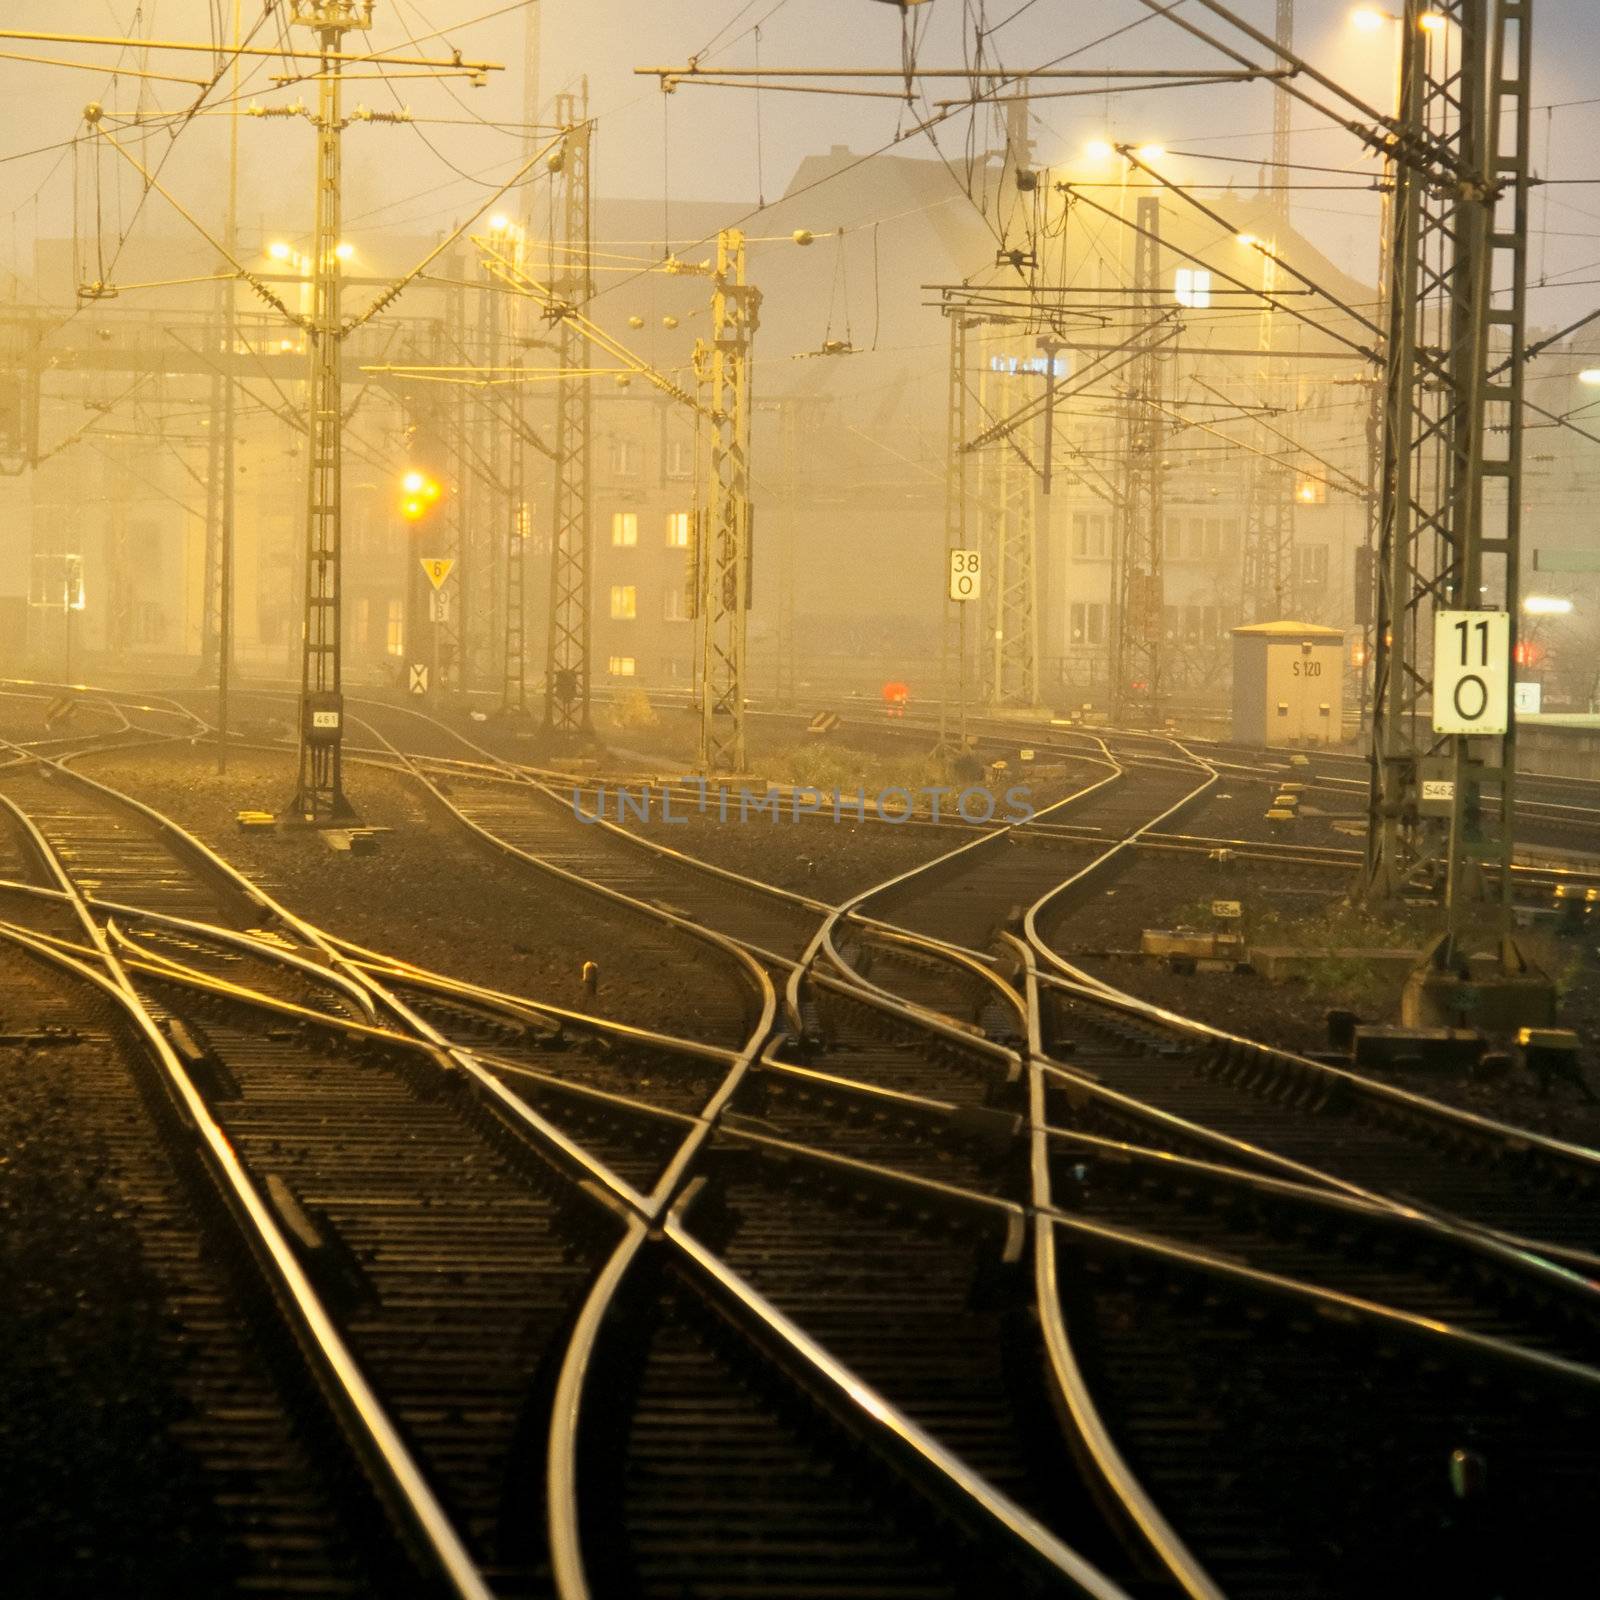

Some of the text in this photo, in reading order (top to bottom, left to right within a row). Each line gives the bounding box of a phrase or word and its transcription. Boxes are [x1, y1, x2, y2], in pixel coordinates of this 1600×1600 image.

[434, 561, 441, 577] 6
[954, 554, 979, 573] 38
[958, 576, 973, 595] 0
[1455, 620, 1489, 666] 11
[1293, 661, 1321, 677] S 120
[1454, 674, 1488, 720] 0
